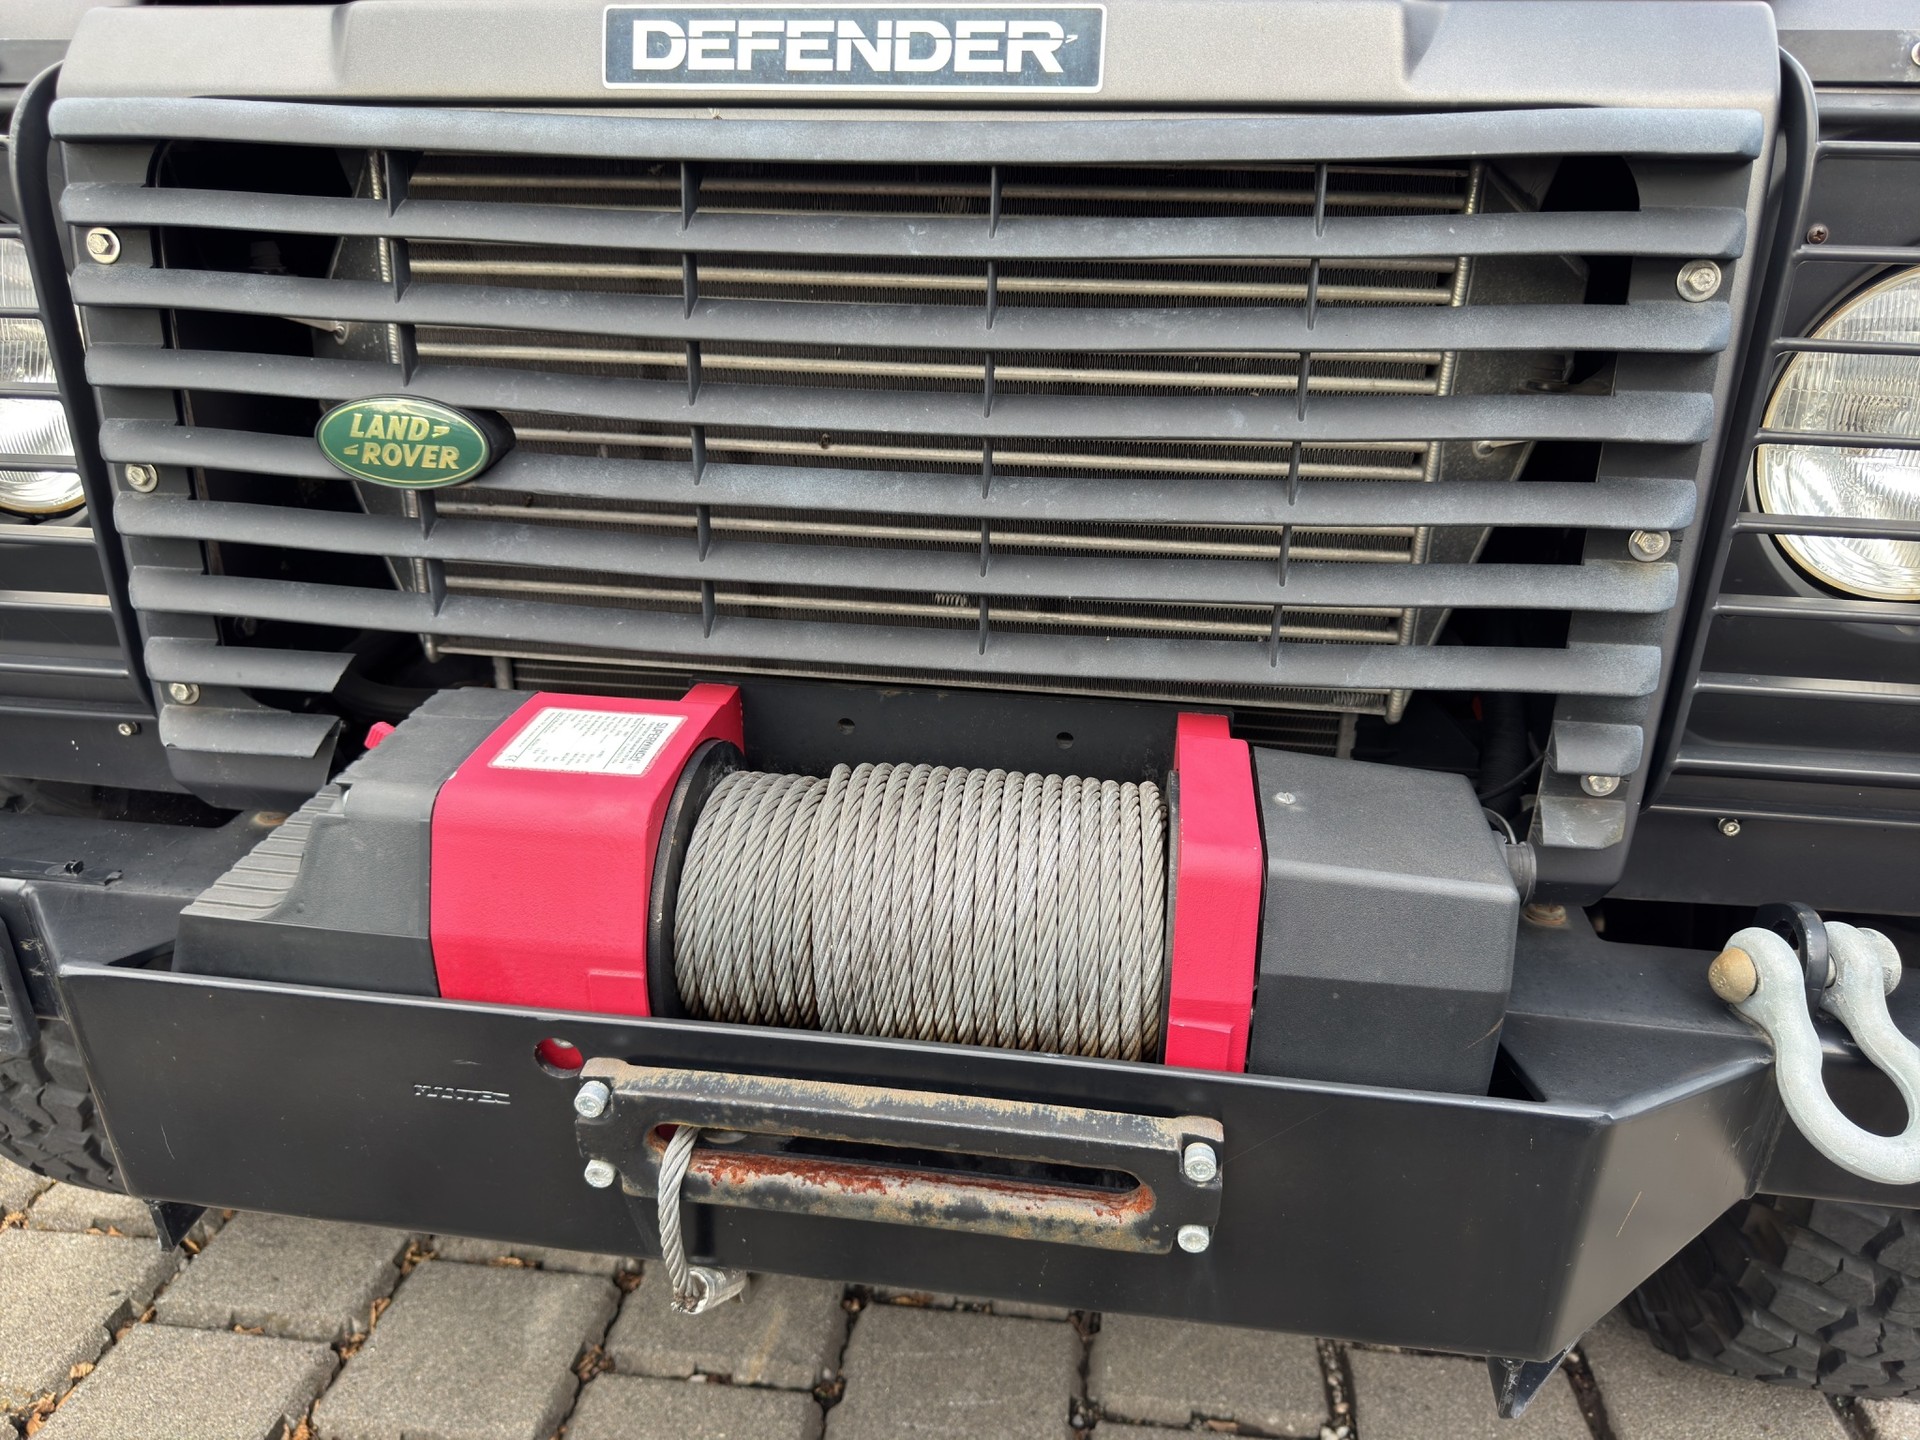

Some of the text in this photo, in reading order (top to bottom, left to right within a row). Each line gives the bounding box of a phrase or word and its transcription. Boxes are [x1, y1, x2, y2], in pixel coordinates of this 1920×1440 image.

[632, 19, 1065, 73] DEFENDER
[349, 412, 431, 442] LAND
[361, 441, 461, 470] ROVER
[633, 722, 669, 763] SUPERWINCH
